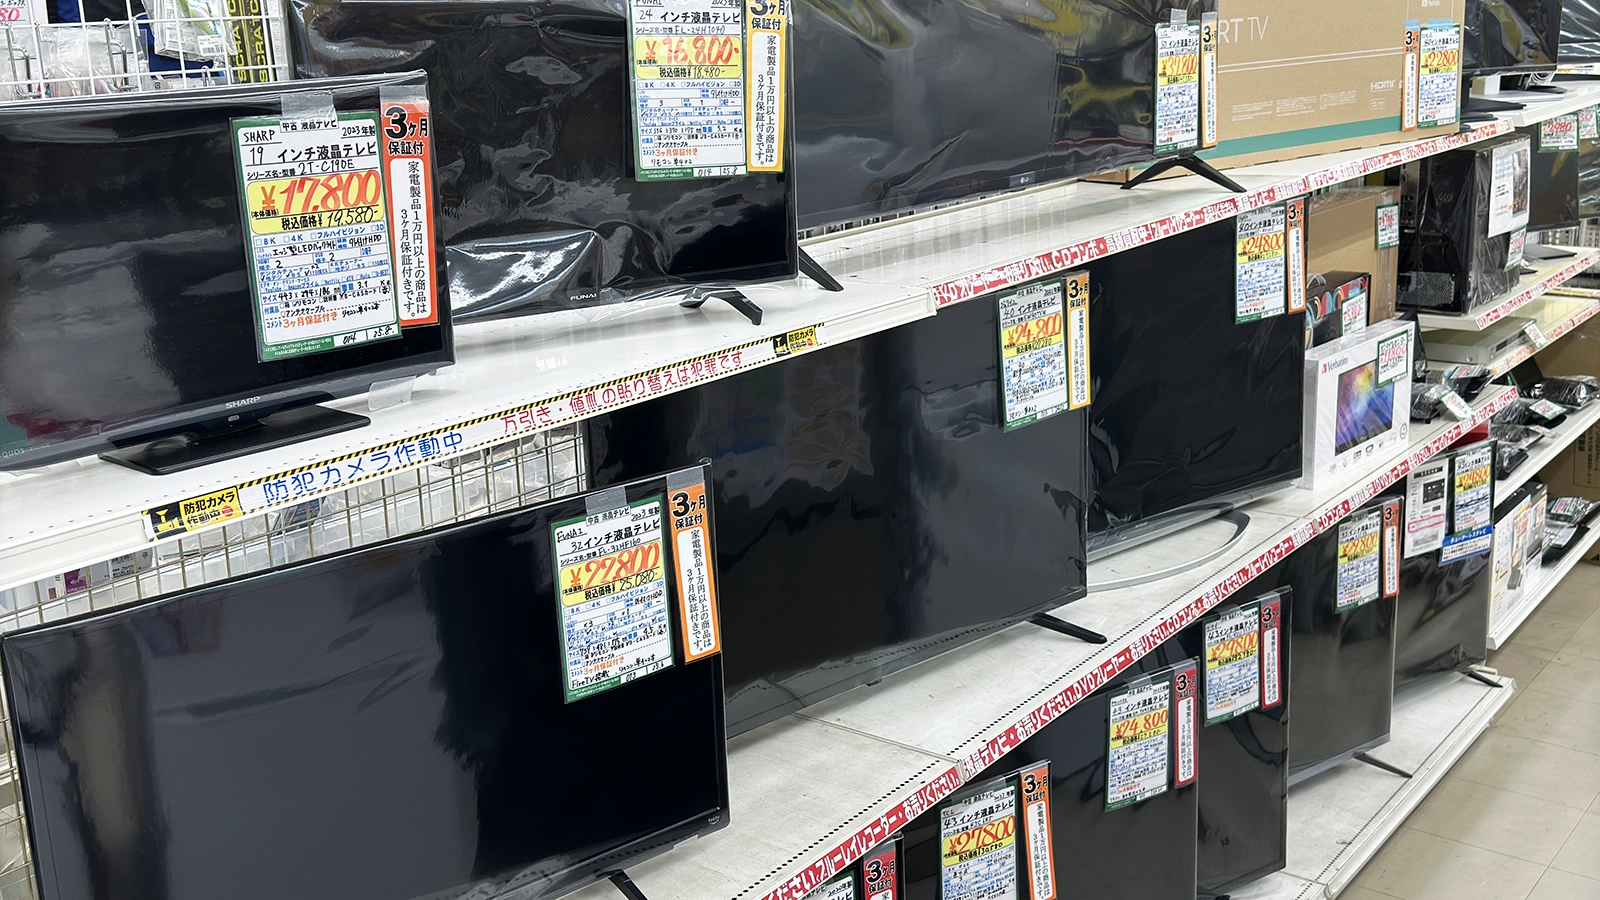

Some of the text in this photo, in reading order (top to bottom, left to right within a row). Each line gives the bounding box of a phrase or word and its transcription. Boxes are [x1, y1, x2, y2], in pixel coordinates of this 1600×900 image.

[750, 0, 785, 16] 3ヶ月
[639, 9, 740, 24] 24 インチ液晶テレビ
[751, 18, 782, 30] 保証付
[1247, 16, 1269, 41] TV
[685, 81, 726, 89] フルハイビジョン
[1370, 80, 1396, 90] HDMI
[765, 35, 777, 162] 家電製品1万円以上の商品は
[282, 119, 338, 131] 中古 液晶テレビ
[384, 106, 428, 140] 3ヶ月
[755, 74, 765, 165] 3ヶ月保証付きです。
[243, 129, 275, 143] SHARP
[342, 125, 376, 136] 2023年製
[250, 141, 377, 165] 19 インチ液晶テレビ
[388, 141, 424, 156] 保証付
[655, 149, 698, 157] 3ヶ月保証付き
[247, 167, 296, 180] シリーズ名・型番
[1288, 203, 1304, 220] 3ヶ月
[263, 237, 276, 245] 8K
[291, 233, 303, 242] 4K
[317, 227, 365, 240] フルハイビジョン
[407, 160, 427, 314] 家電製品1万円以上の商品は
[399, 209, 416, 318] 3ヶ月保証付きです。
[570, 293, 597, 301] FUNAI
[1068, 279, 1089, 299] 3ヶ月
[1003, 308, 1015, 319] 40
[1017, 295, 1056, 314] インチ液晶テレビ
[1070, 298, 1086, 308] 保証付
[282, 312, 338, 328] 3ヶ月保証付き
[1327, 356, 1349, 372] Verbatim
[225, 396, 260, 409] SHARP
[0, 448, 25, 458] QUOS
[263, 431, 464, 505] 防犯カメラ作動中
[183, 490, 236, 516] 防犯カメラ
[672, 491, 706, 518] 3ヶ月
[186, 509, 221, 528] 作動中
[602, 508, 630, 521] 液晶テレビ
[675, 515, 703, 531] 保証付
[571, 518, 660, 553] 32 インチ液晶テレビ
[610, 587, 648, 603] フルハイビジョン
[691, 529, 712, 648] 家電製品1万円以上の商品は
[686, 569, 703, 651] 3ヶ月保証付きです。
[1263, 607, 1280, 623] 3ヶ月
[1220, 619, 1258, 635] インチ液晶テレビ
[583, 657, 624, 675] 3ヶ月保証付き
[1176, 674, 1196, 691] 3ヶ月
[1178, 688, 1194, 698] 保証付
[1125, 693, 1169, 712] インチ液晶テレビ
[1024, 774, 1047, 794] 3ヶ月
[1026, 791, 1045, 803] 保証付
[944, 800, 1014, 829] 43 インチ液晶テレビ
[867, 859, 895, 884] 3ヶ月
[868, 878, 892, 894] 保証付
